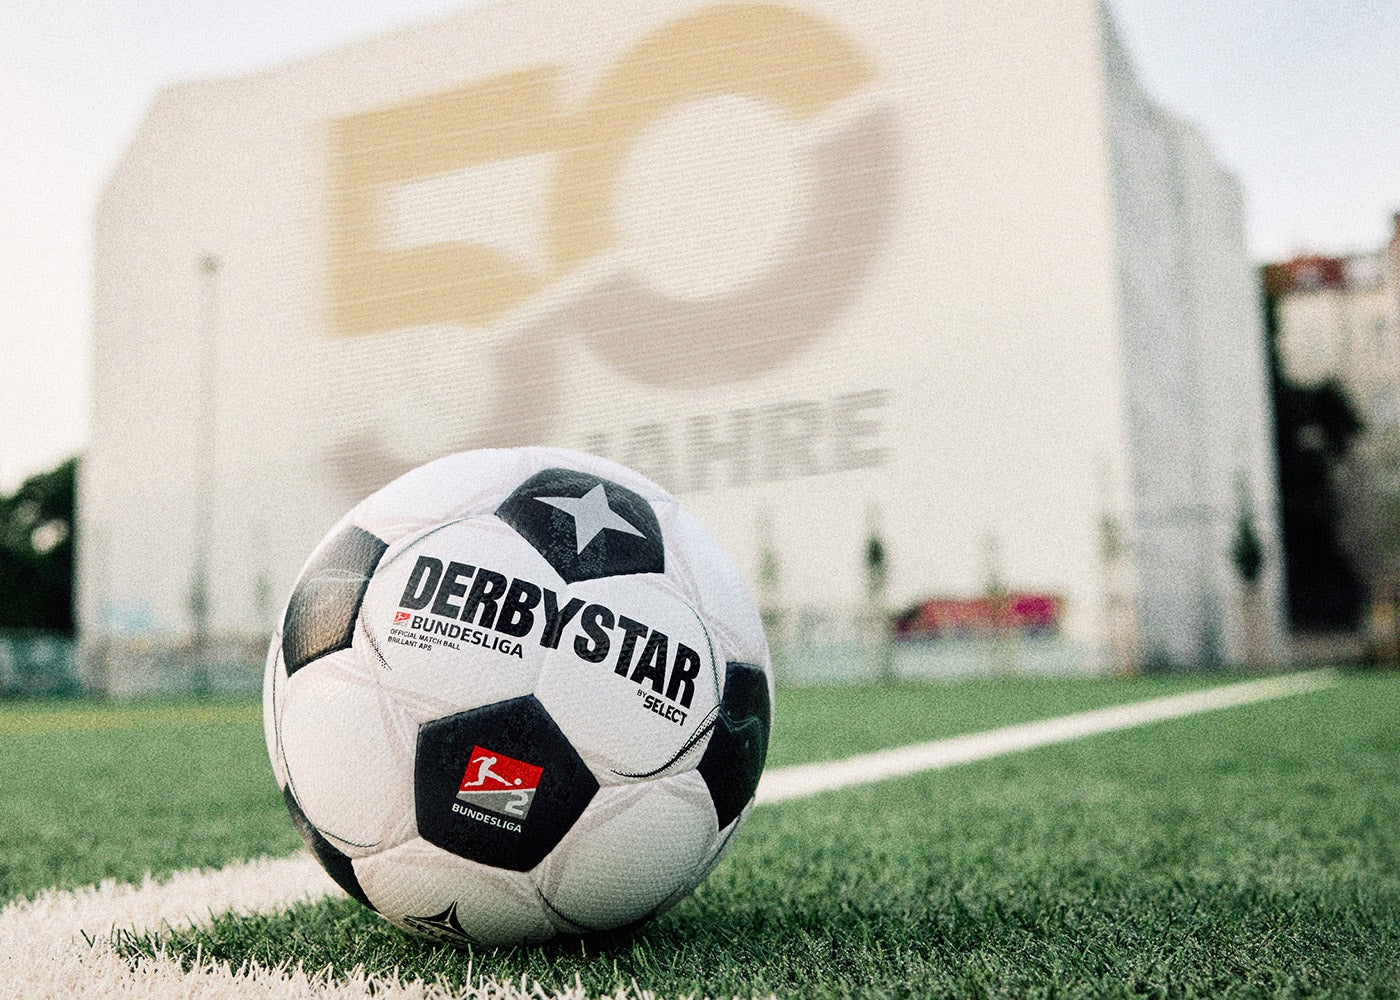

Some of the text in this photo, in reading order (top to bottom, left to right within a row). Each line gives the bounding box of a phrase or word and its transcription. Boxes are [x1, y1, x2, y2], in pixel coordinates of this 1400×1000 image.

[324, 3, 900, 502] 50
[388, 635, 433, 651] BRILLANT APS
[390, 628, 461, 650] OFFICIAL MATCH BALL
[399, 556, 700, 709] DERBYSTAR
[411, 615, 523, 658] BUNDESLIGA
[637, 689, 647, 698] BY
[643, 695, 687, 726] SELECT
[452, 803, 522, 833] BUNDESLIGA
[504, 791, 529, 816] 2
